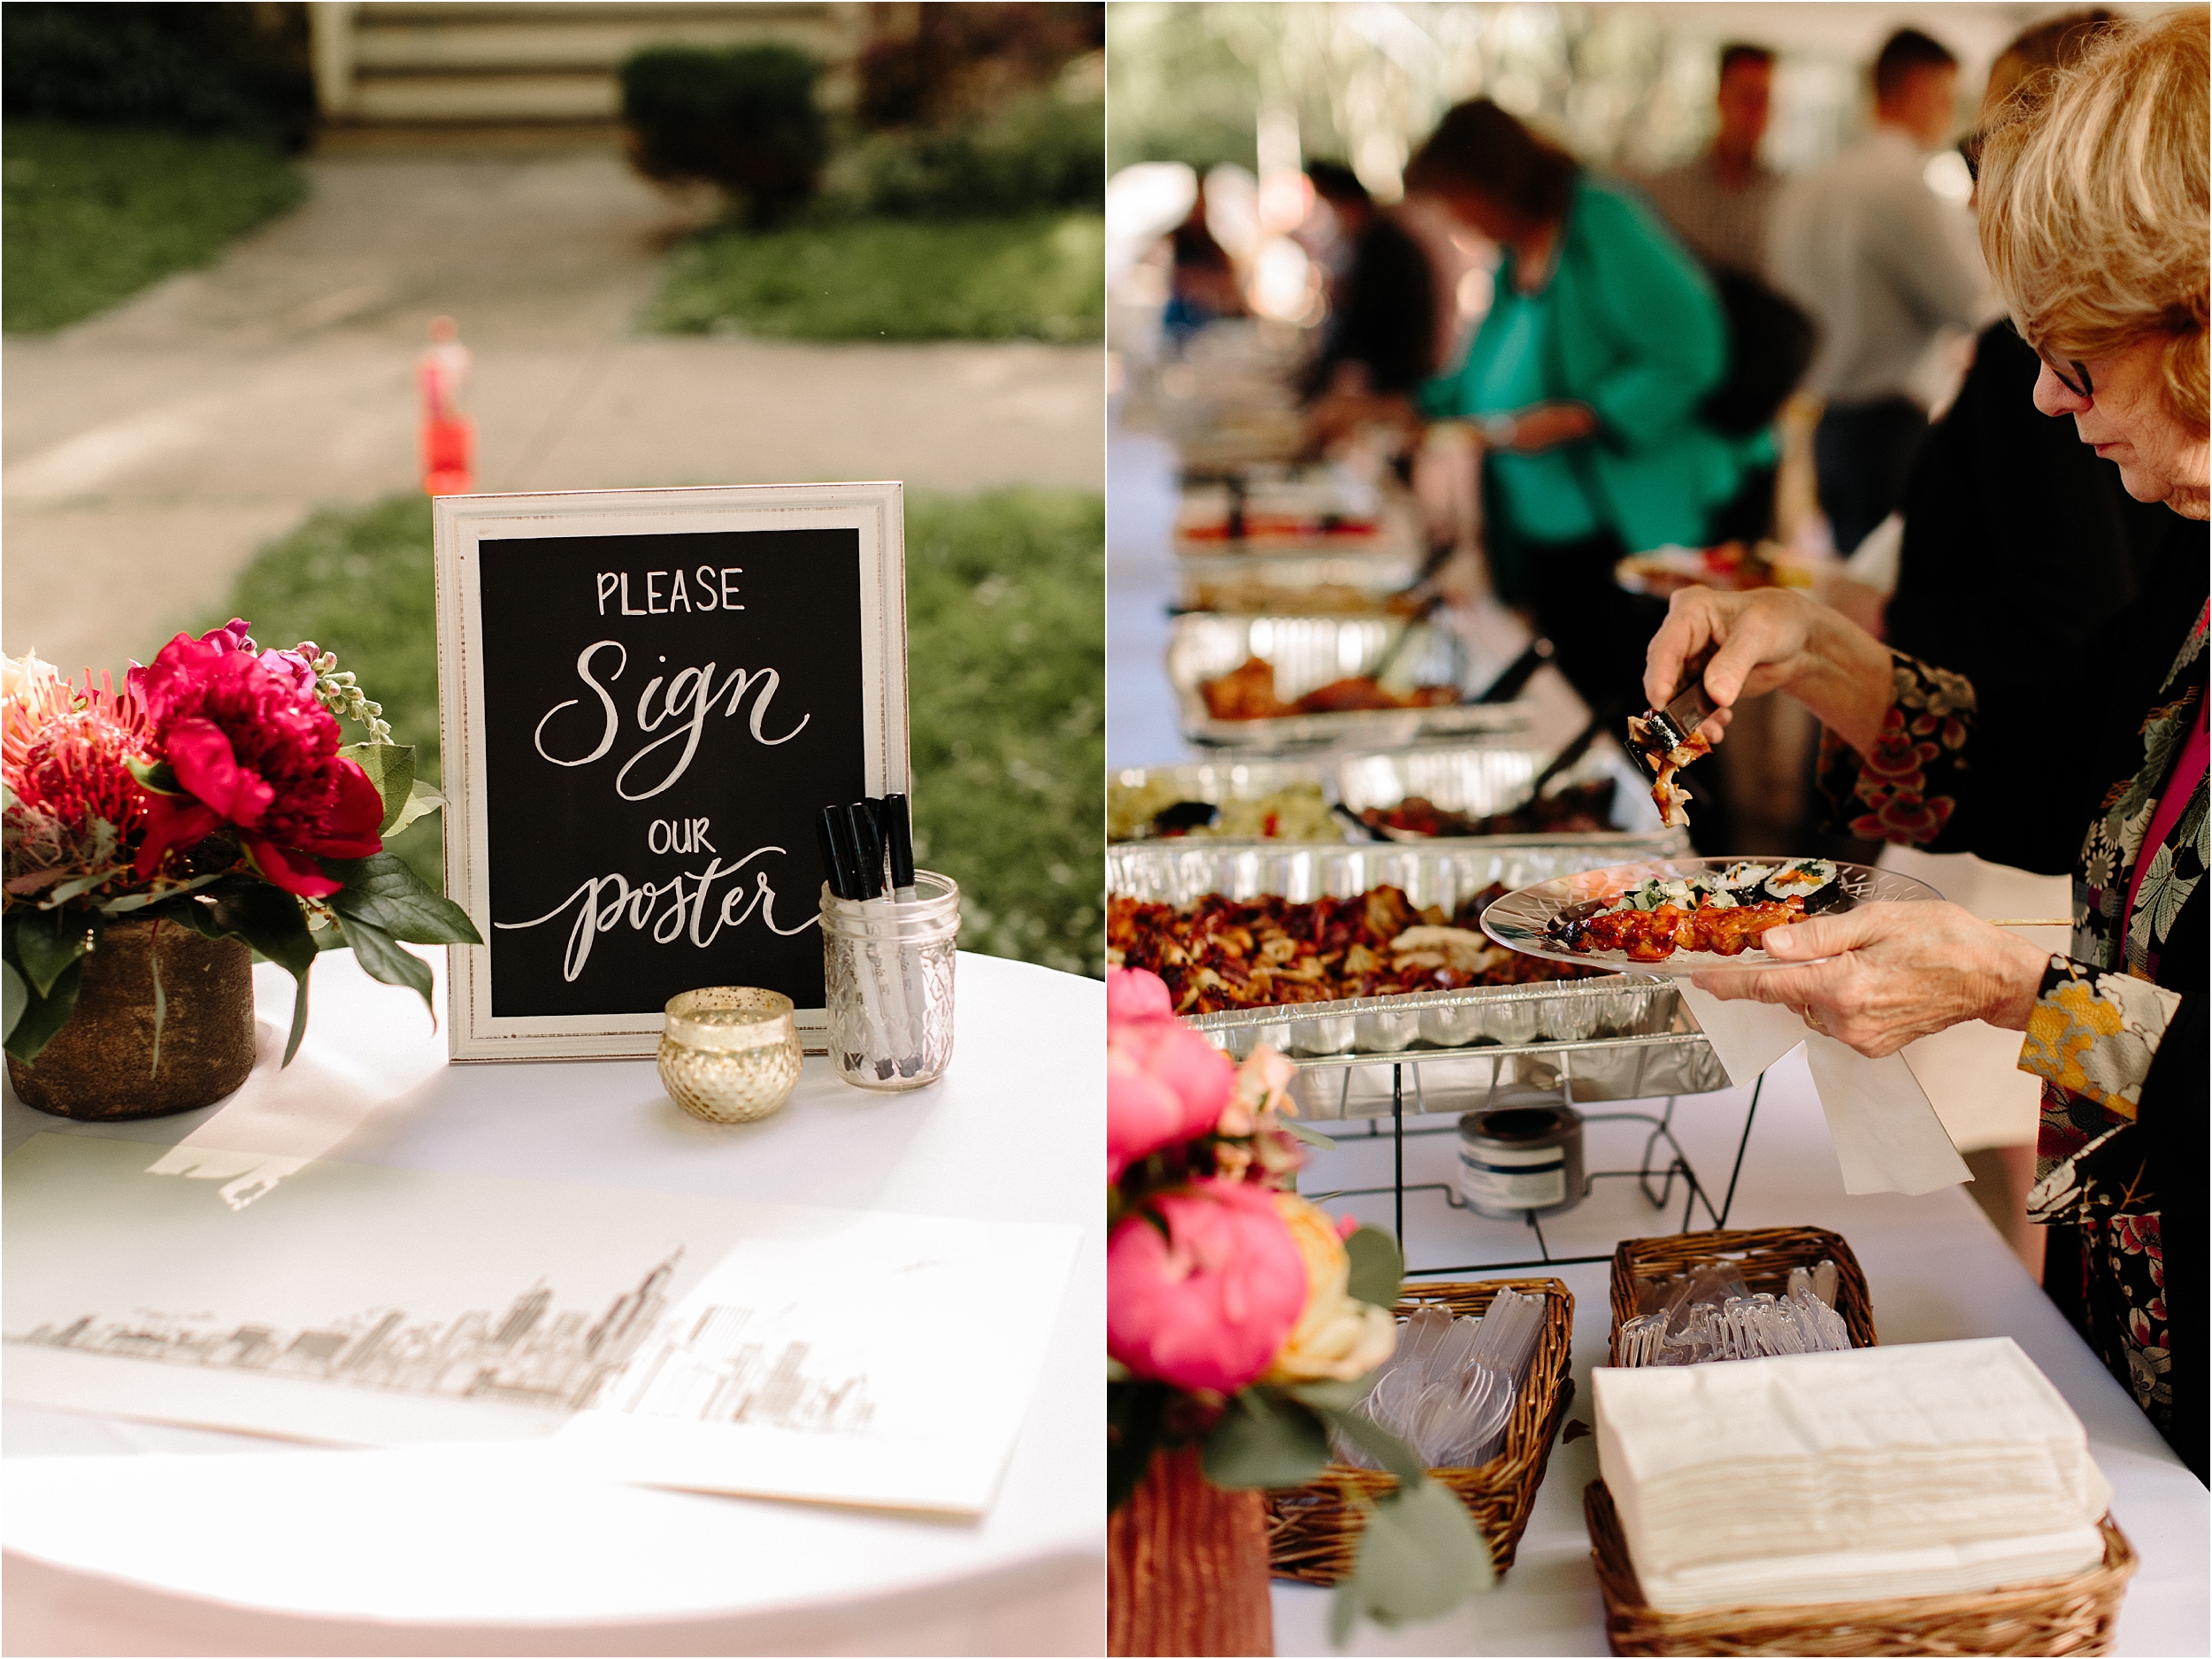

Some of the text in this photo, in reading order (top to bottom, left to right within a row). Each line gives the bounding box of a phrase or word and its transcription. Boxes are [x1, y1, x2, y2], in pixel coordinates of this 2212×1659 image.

[597, 566, 745, 615] PLEASE
[535, 641, 810, 801] Sign
[649, 818, 717, 854] OUR
[495, 847, 819, 981] poster
